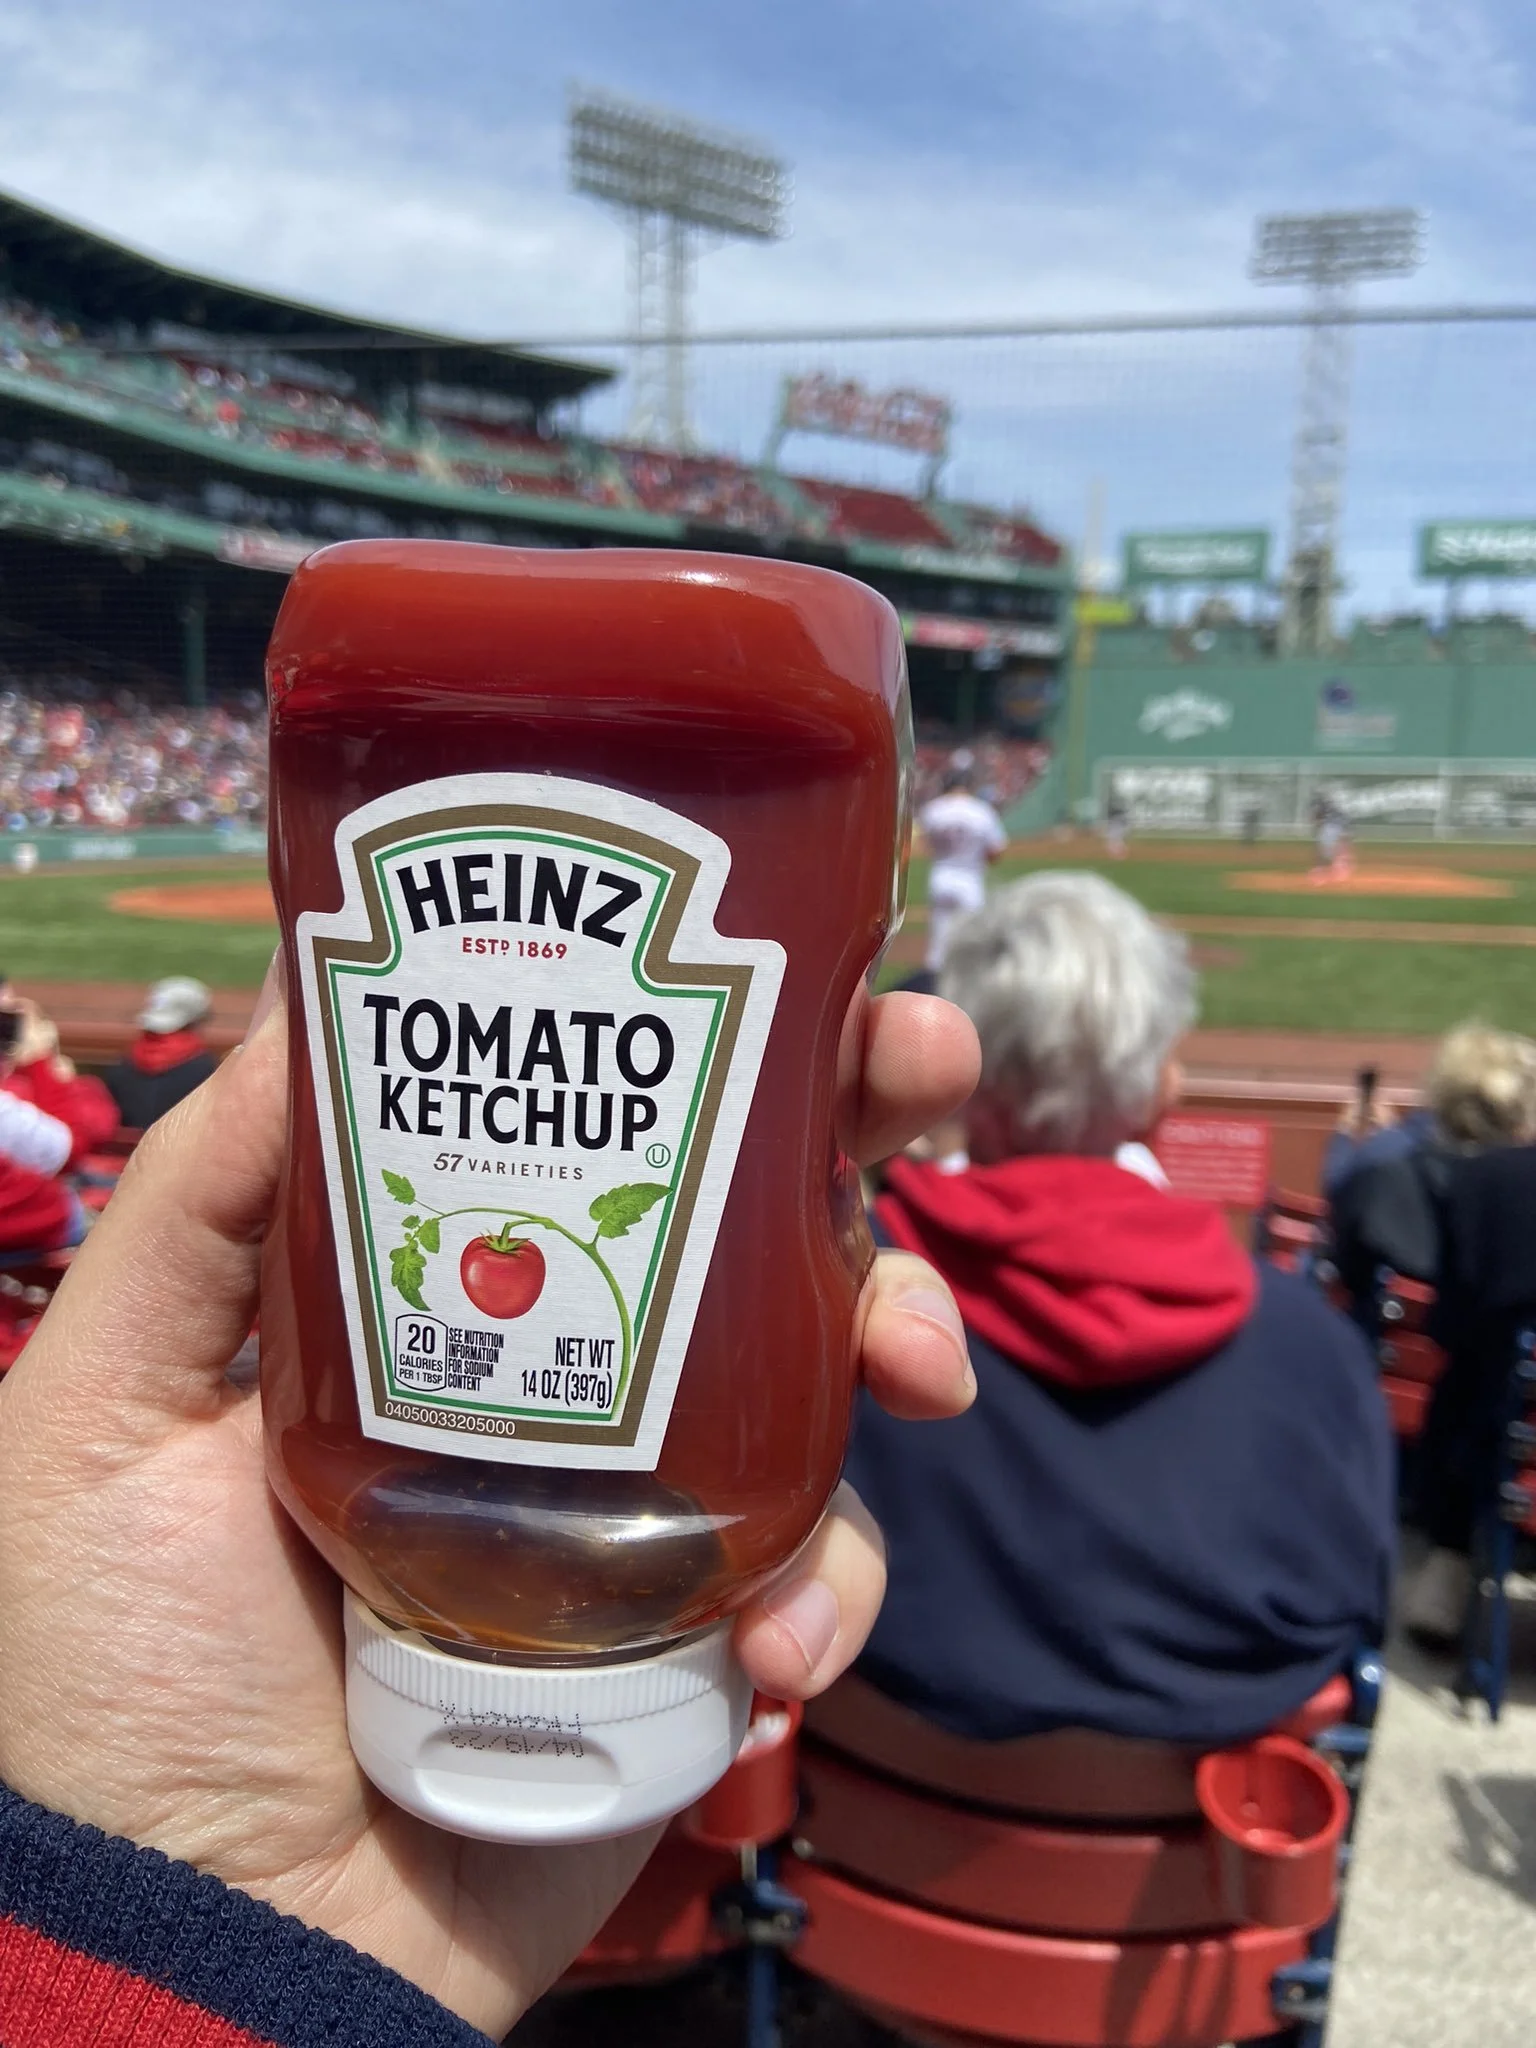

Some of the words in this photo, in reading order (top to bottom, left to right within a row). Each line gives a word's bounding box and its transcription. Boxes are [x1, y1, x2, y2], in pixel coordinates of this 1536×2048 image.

[396, 853, 643, 948] HEINZ
[518, 940, 568, 959] 1869
[363, 993, 675, 1089] TOMATO
[379, 1073, 658, 1151] KETCHUP
[433, 1152, 464, 1172] 57
[468, 1158, 583, 1180] VARIETIES
[407, 1323, 435, 1354] 20
[448, 1327, 463, 1344] SEE
[464, 1329, 504, 1348] NUTRITION
[399, 1353, 443, 1372] CALORIES
[448, 1342, 500, 1363] INFORMATION
[555, 1336, 586, 1368] NET
[589, 1338, 615, 1369] WT
[399, 1368, 414, 1380] PER
[416, 1371, 420, 1382] 1
[423, 1372, 443, 1385] TBSP
[447, 1372, 481, 1391] CONTENT
[448, 1358, 463, 1374] FOR
[464, 1360, 494, 1378] SODIUM
[521, 1369, 537, 1398] 14
[541, 1369, 561, 1400] OZ
[565, 1370, 613, 1409] (397g)
[385, 1401, 516, 1436] 04050033205000
[448, 1729, 585, 1758] 04/19/23
